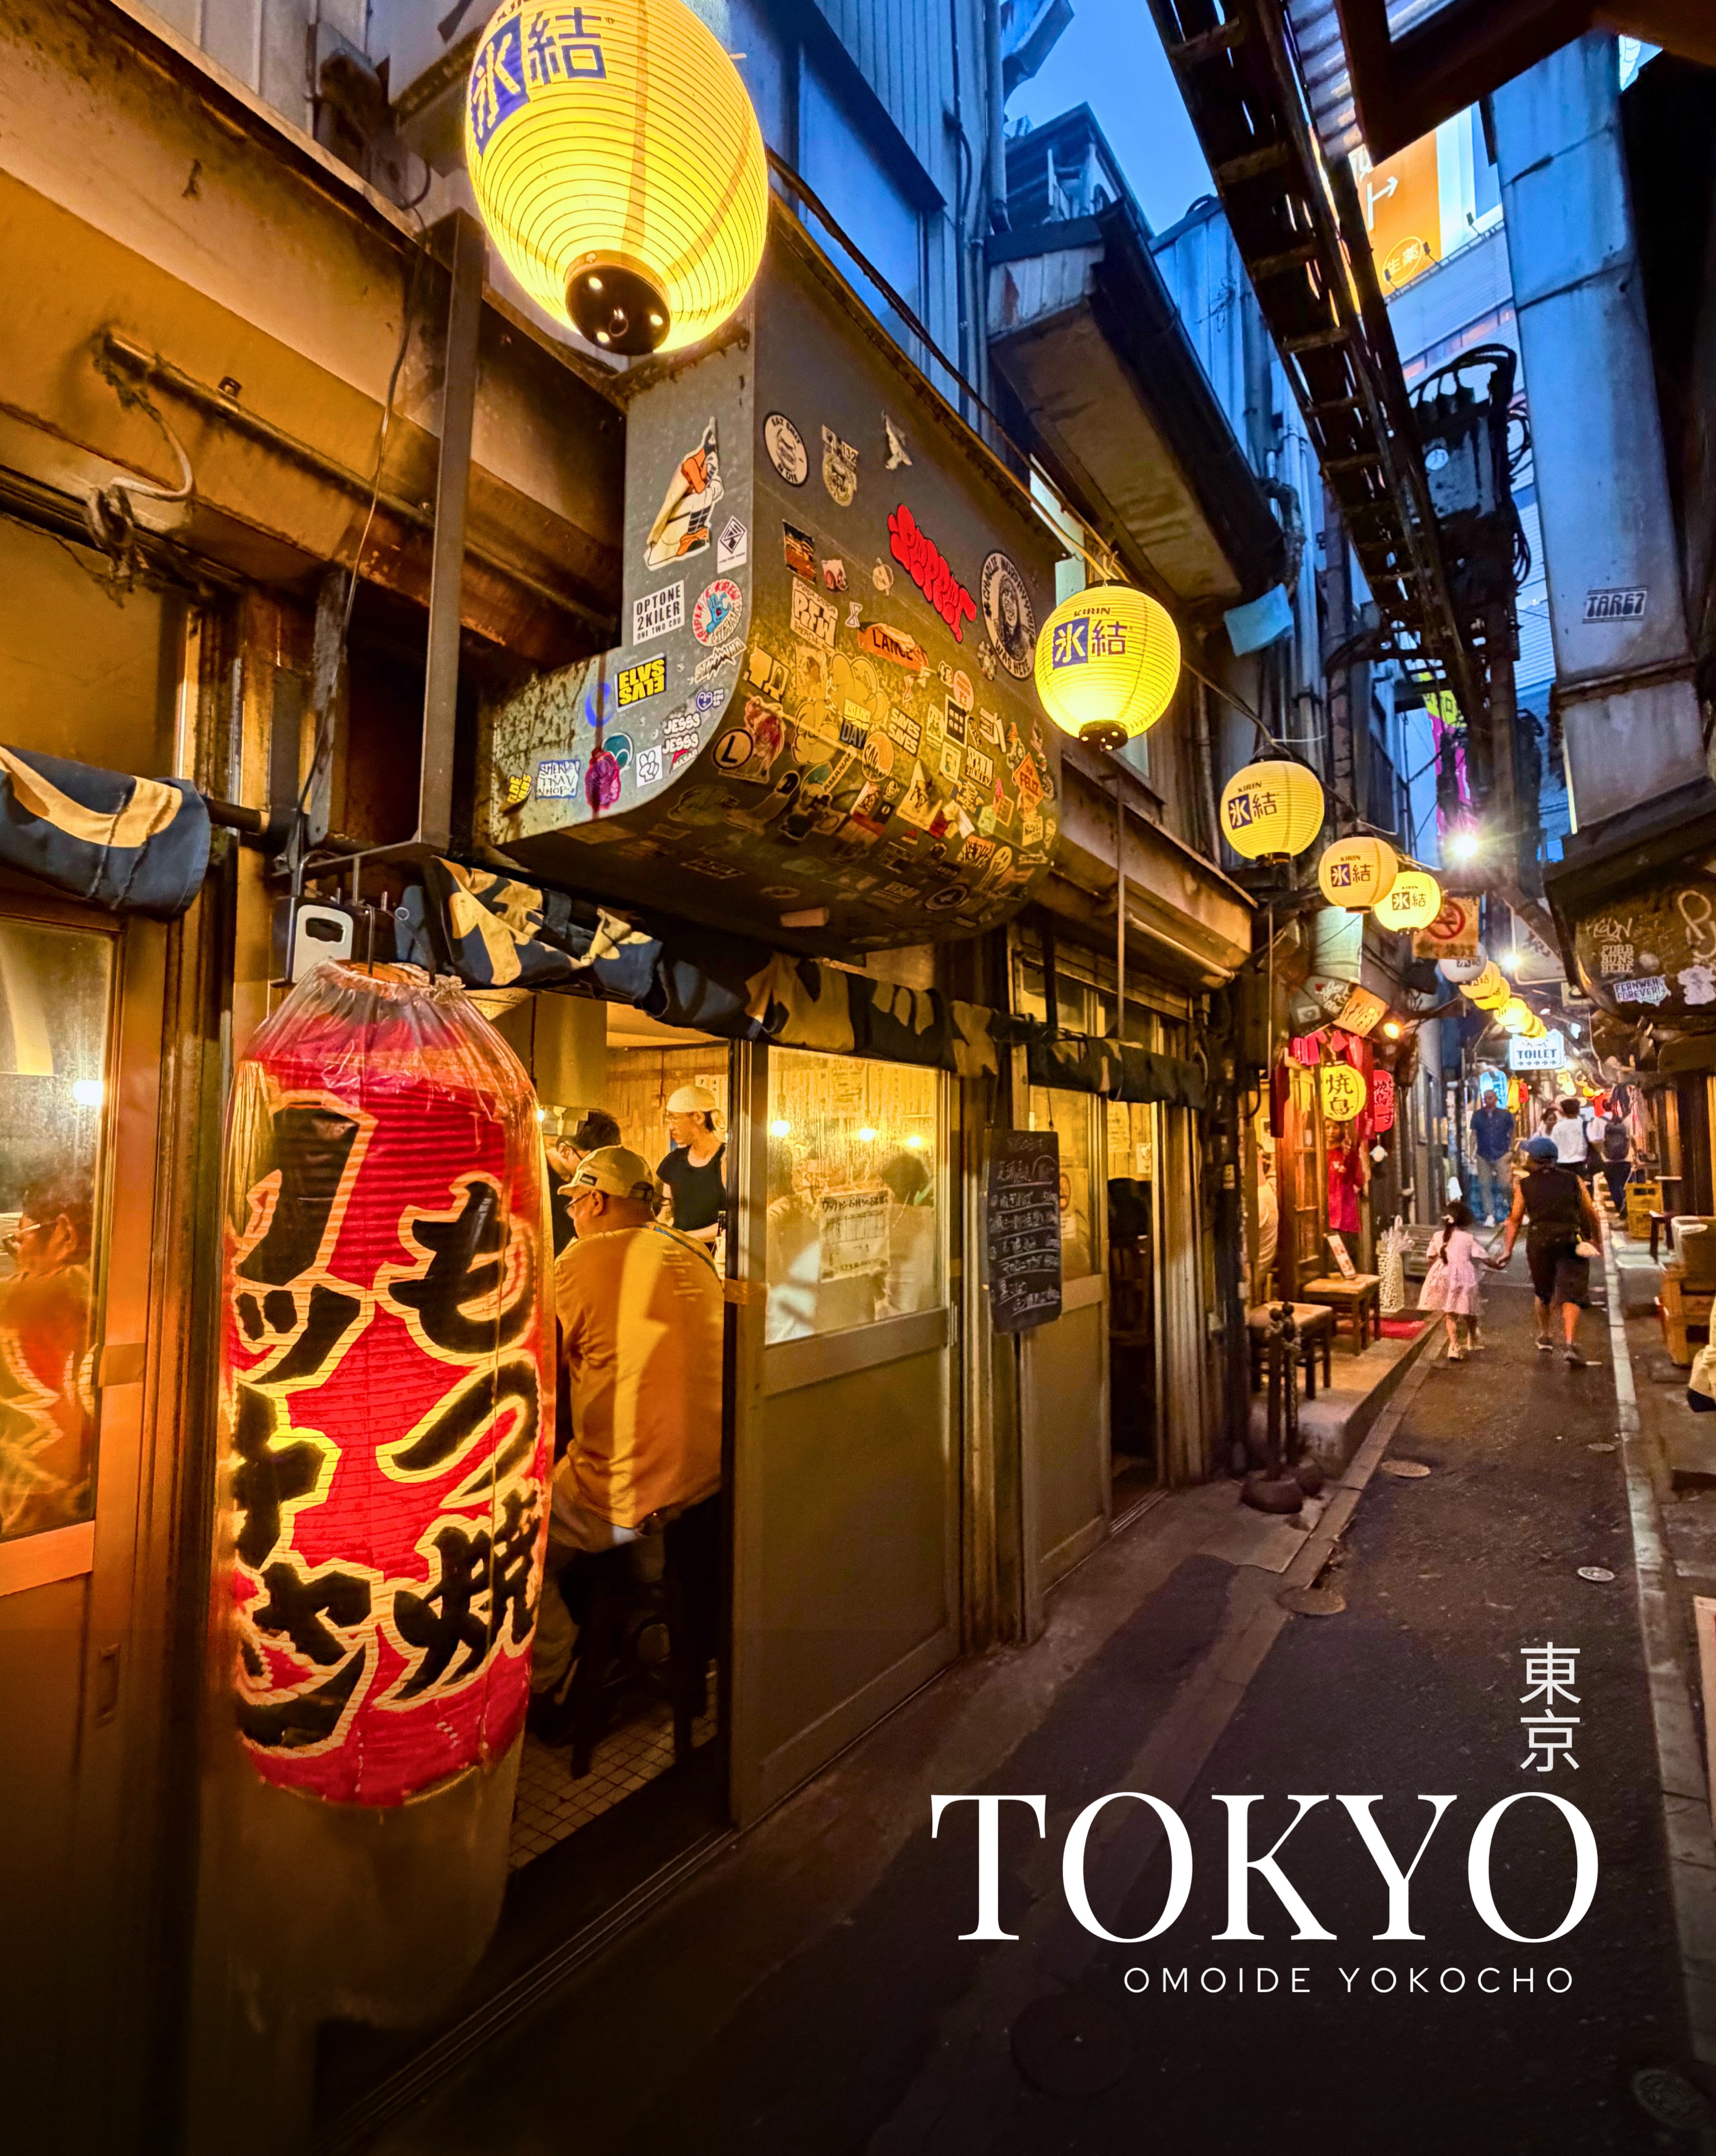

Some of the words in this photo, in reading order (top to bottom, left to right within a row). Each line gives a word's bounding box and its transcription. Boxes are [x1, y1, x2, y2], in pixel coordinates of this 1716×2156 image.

[472, 7, 607, 142] 氷結
[636, 584, 681, 615] OPTONE
[1074, 607, 1111, 617] KIRIN
[637, 601, 680, 631] 2KILER
[637, 630, 649, 641] ONE
[652, 623, 666, 635] TWO
[1054, 620, 1128, 663] 氷結
[618, 658, 665, 688] ELVS
[841, 721, 867, 747] DAY
[721, 735, 737, 764] L
[1238, 781, 1262, 793] KIRIN
[1229, 792, 1277, 826] 氷結
[1332, 864, 1372, 886] 氷結
[1393, 892, 1426, 910] 氷結
[1615, 978, 1659, 993] FERNWEH
[1517, 1049, 1558, 1059] TOILET
[1325, 1073, 1354, 1116] 焼鳥
